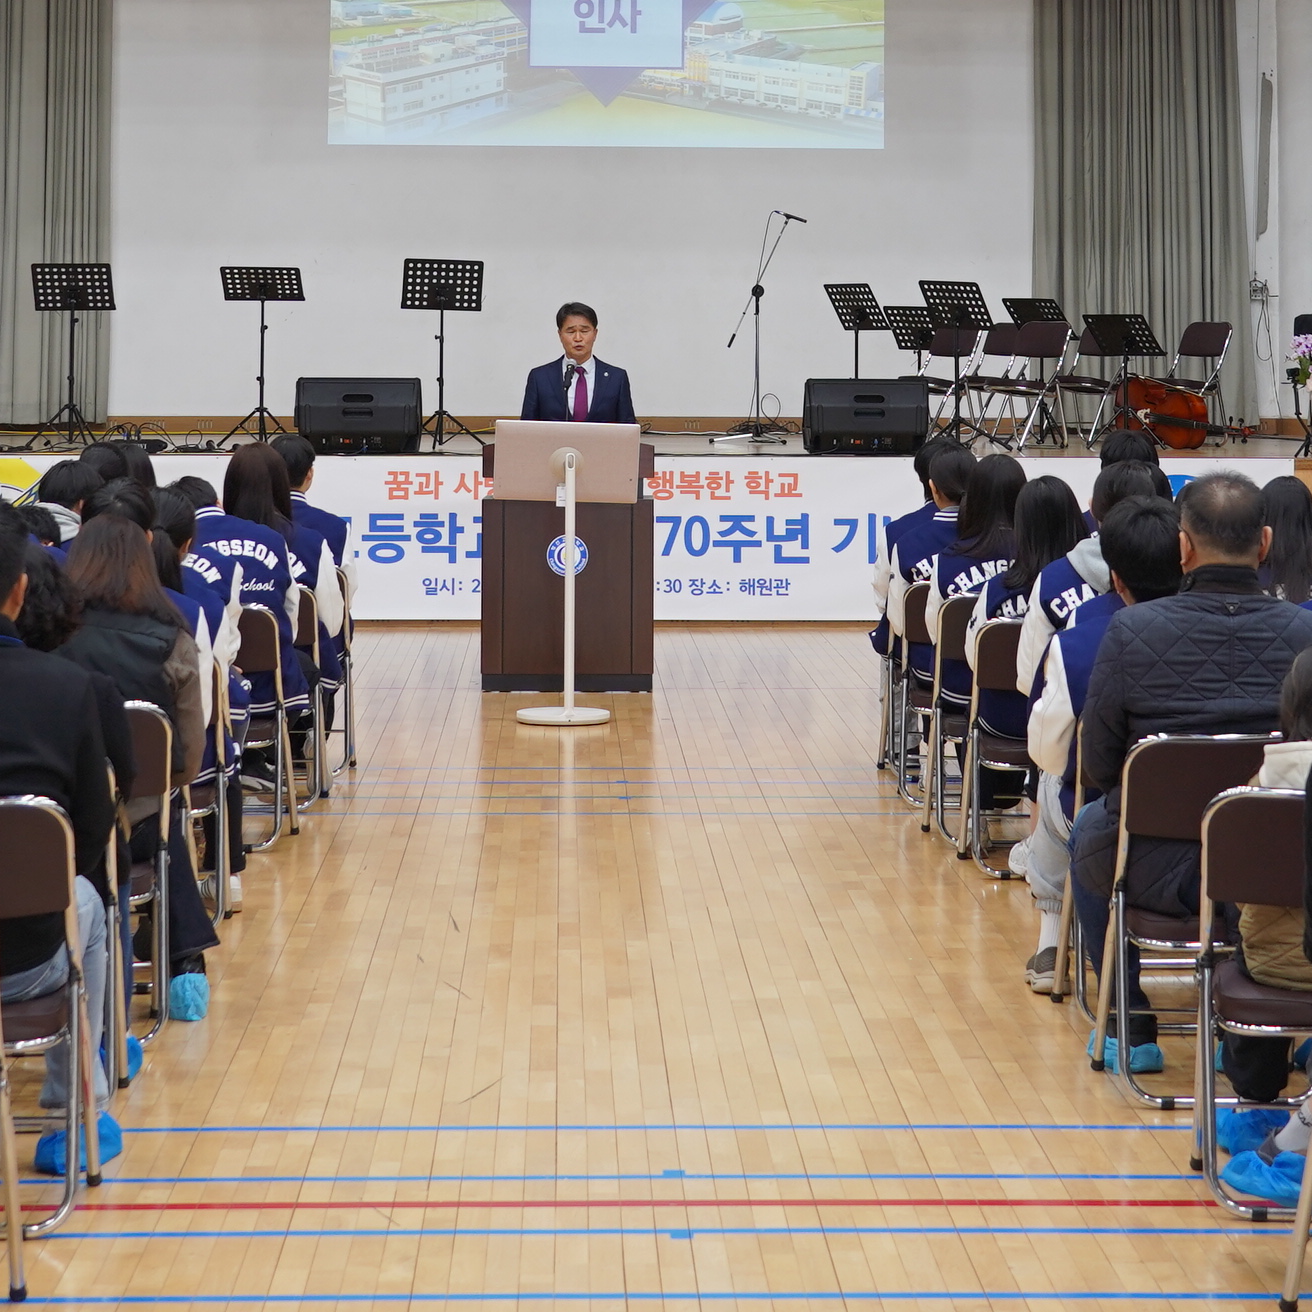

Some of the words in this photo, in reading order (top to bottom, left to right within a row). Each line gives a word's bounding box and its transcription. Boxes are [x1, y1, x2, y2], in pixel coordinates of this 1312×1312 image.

[383, 470, 444, 501] 꿈과
[646, 470, 735, 501] 행복한
[744, 470, 804, 501] 학교
[655, 512, 811, 564] 70주년
[201, 539, 279, 571] GSEON
[421, 576, 464, 596] 일시:
[688, 577, 731, 596] 장소:
[738, 577, 791, 597] 해원관
